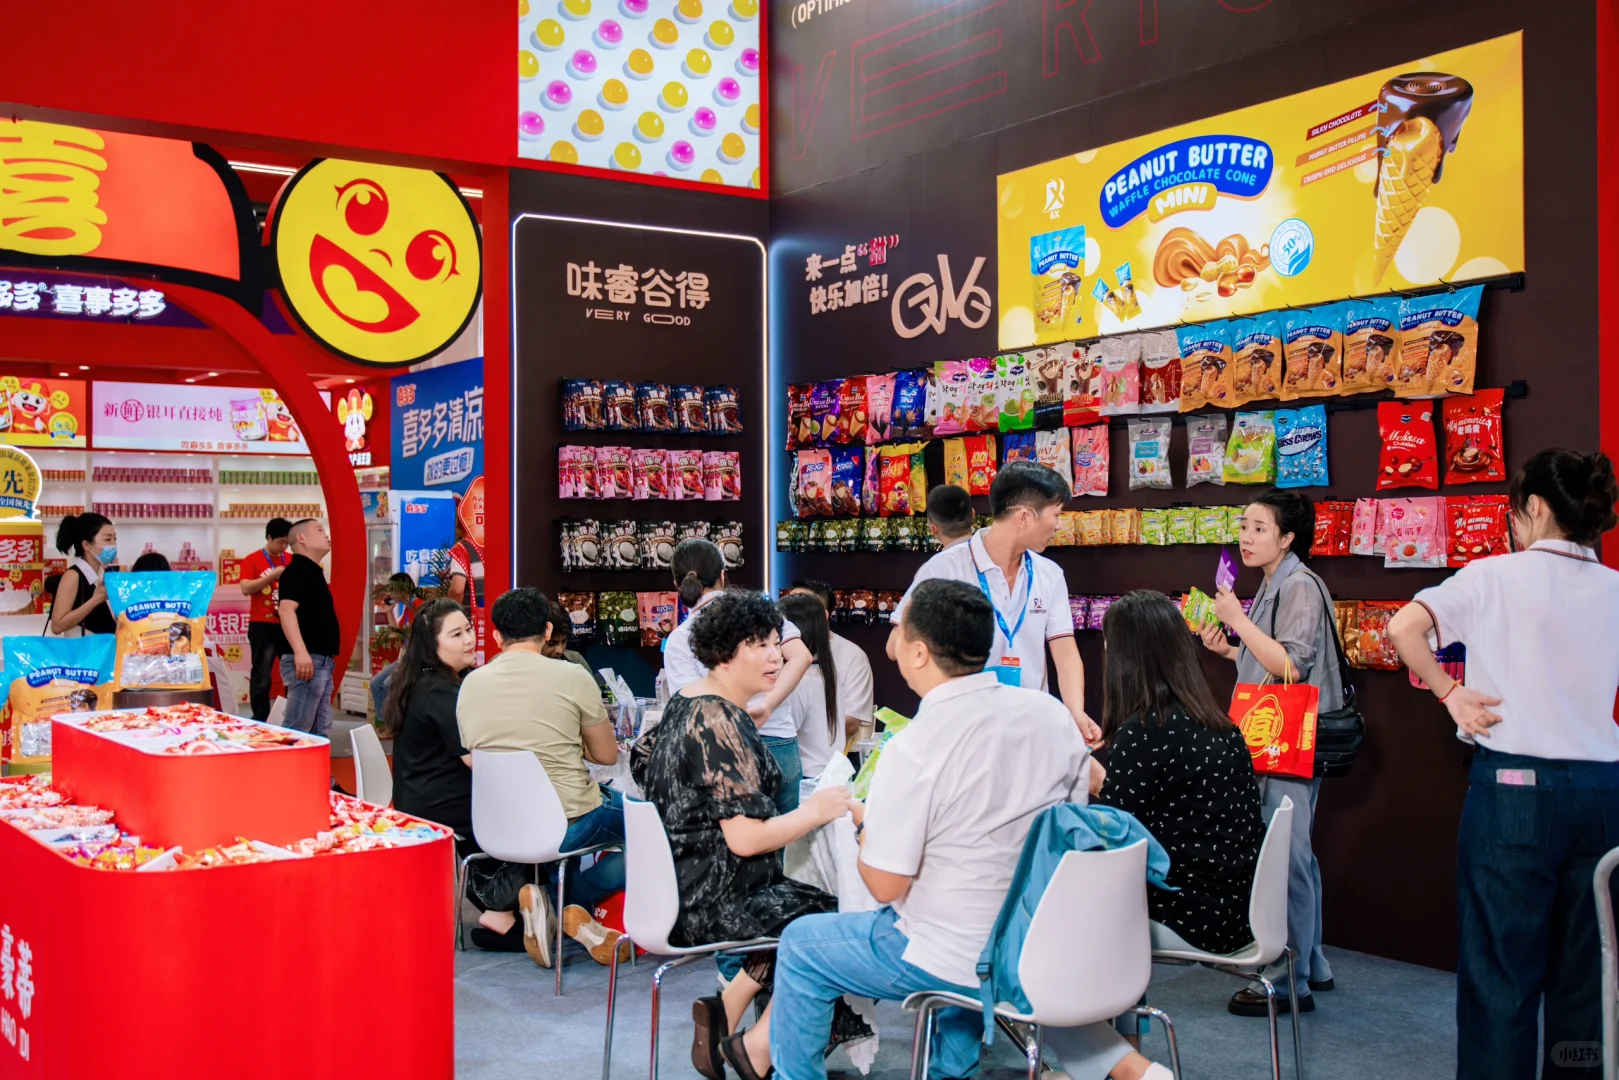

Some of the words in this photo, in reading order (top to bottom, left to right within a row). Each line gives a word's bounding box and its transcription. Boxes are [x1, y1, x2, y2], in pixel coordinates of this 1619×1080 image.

[791, 0, 851, 29] (OPTIM
[1310, 123, 1328, 136] SILKY
[1328, 109, 1363, 129] CHOCOLATE
[1105, 150, 1178, 204] PEANUT
[1188, 142, 1269, 169] BUTTER
[1108, 187, 1150, 218] WAFFLE
[1153, 166, 1221, 188] CHOCOLATE
[1224, 170, 1257, 186] CONE
[1154, 185, 1209, 215] MINI
[1038, 253, 1058, 268] PEANUT
[1059, 252, 1079, 262] BUTTER
[566, 260, 711, 310] 味睿谷得
[53, 284, 166, 319] 喜事多多
[585, 308, 631, 322] VERY
[643, 313, 691, 327] GOOD
[1401, 311, 1432, 324] PEANUT
[1434, 310, 1463, 320] BUTTER
[1383, 429, 1426, 445] Melissa
[127, 602, 161, 614] PEANUT
[29, 668, 62, 680] PEANUT
[65, 669, 99, 678] BUTTER
